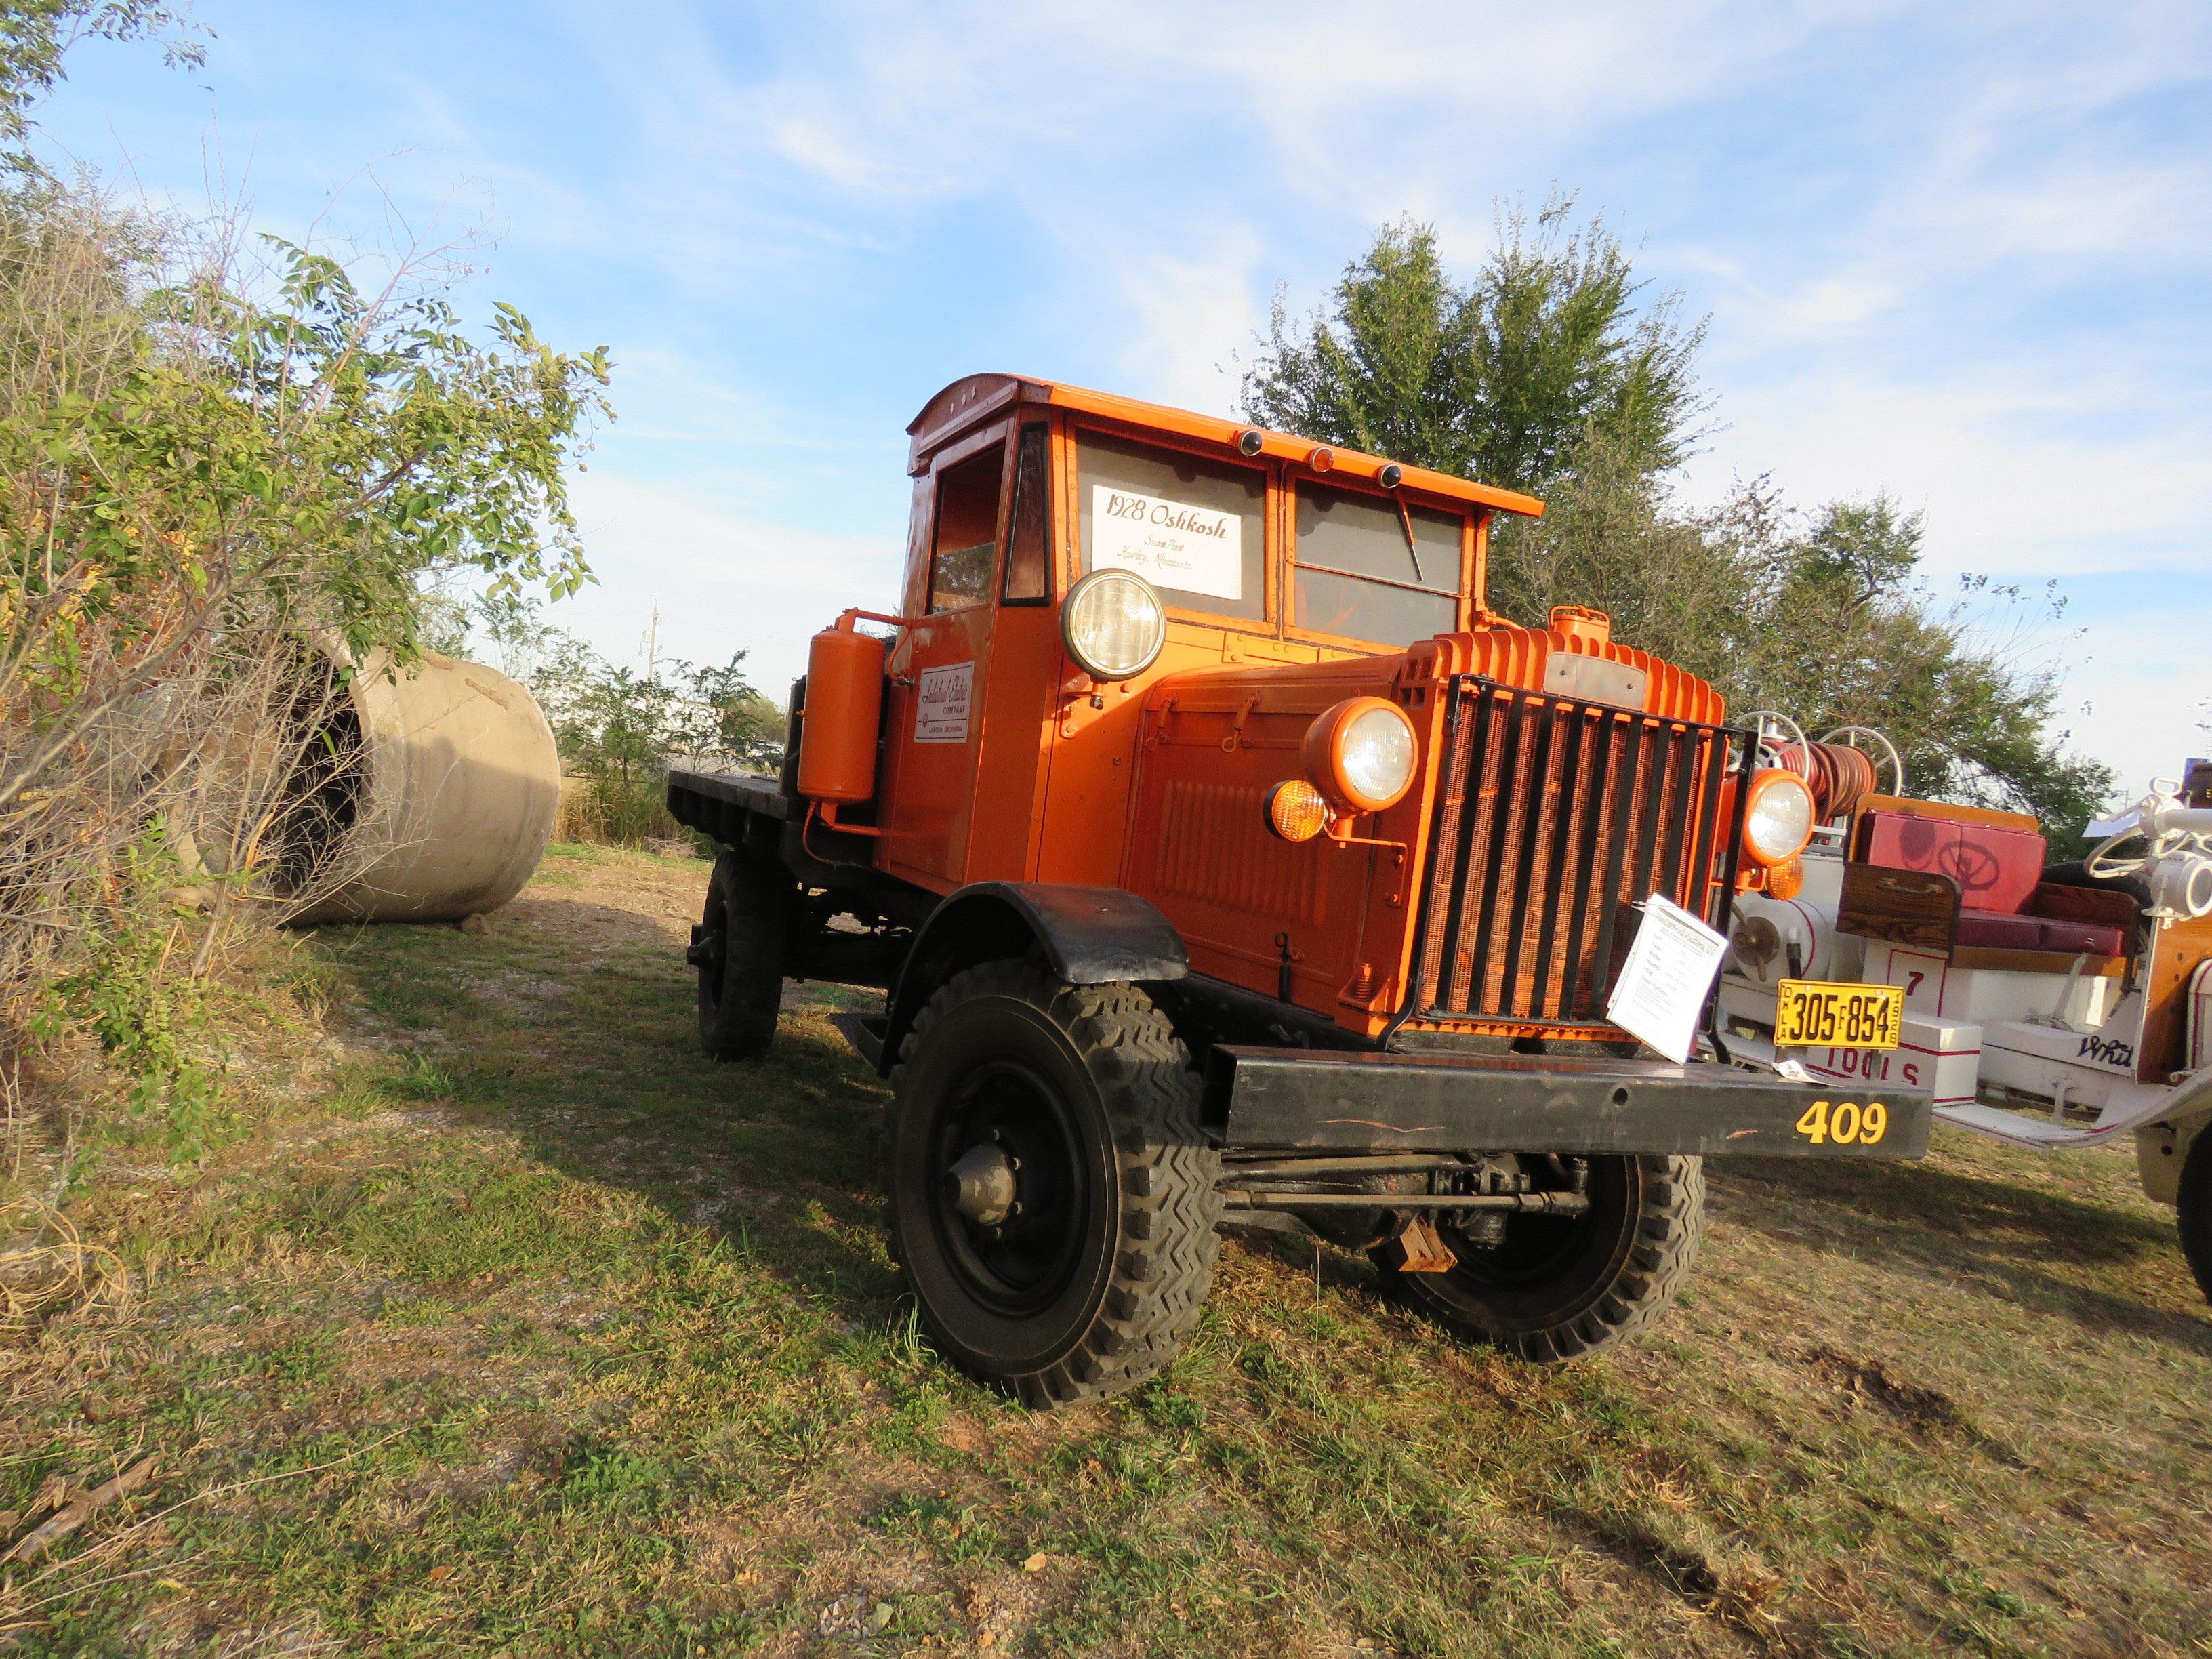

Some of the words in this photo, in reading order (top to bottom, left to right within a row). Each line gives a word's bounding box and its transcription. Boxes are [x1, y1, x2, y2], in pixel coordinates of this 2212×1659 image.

[1106, 493, 1147, 521] 1928
[1150, 505, 1228, 539] Oshkosh
[943, 705, 966, 716] COMPANY
[1906, 971, 1924, 997] 7
[1780, 987, 1793, 1039] OKLA
[1789, 993, 1838, 1041] 305
[1845, 995, 1889, 1043] 854
[1889, 991, 1902, 1044] 1928
[2077, 1036, 2134, 1068] Whit
[1796, 1101, 1888, 1144] 409
